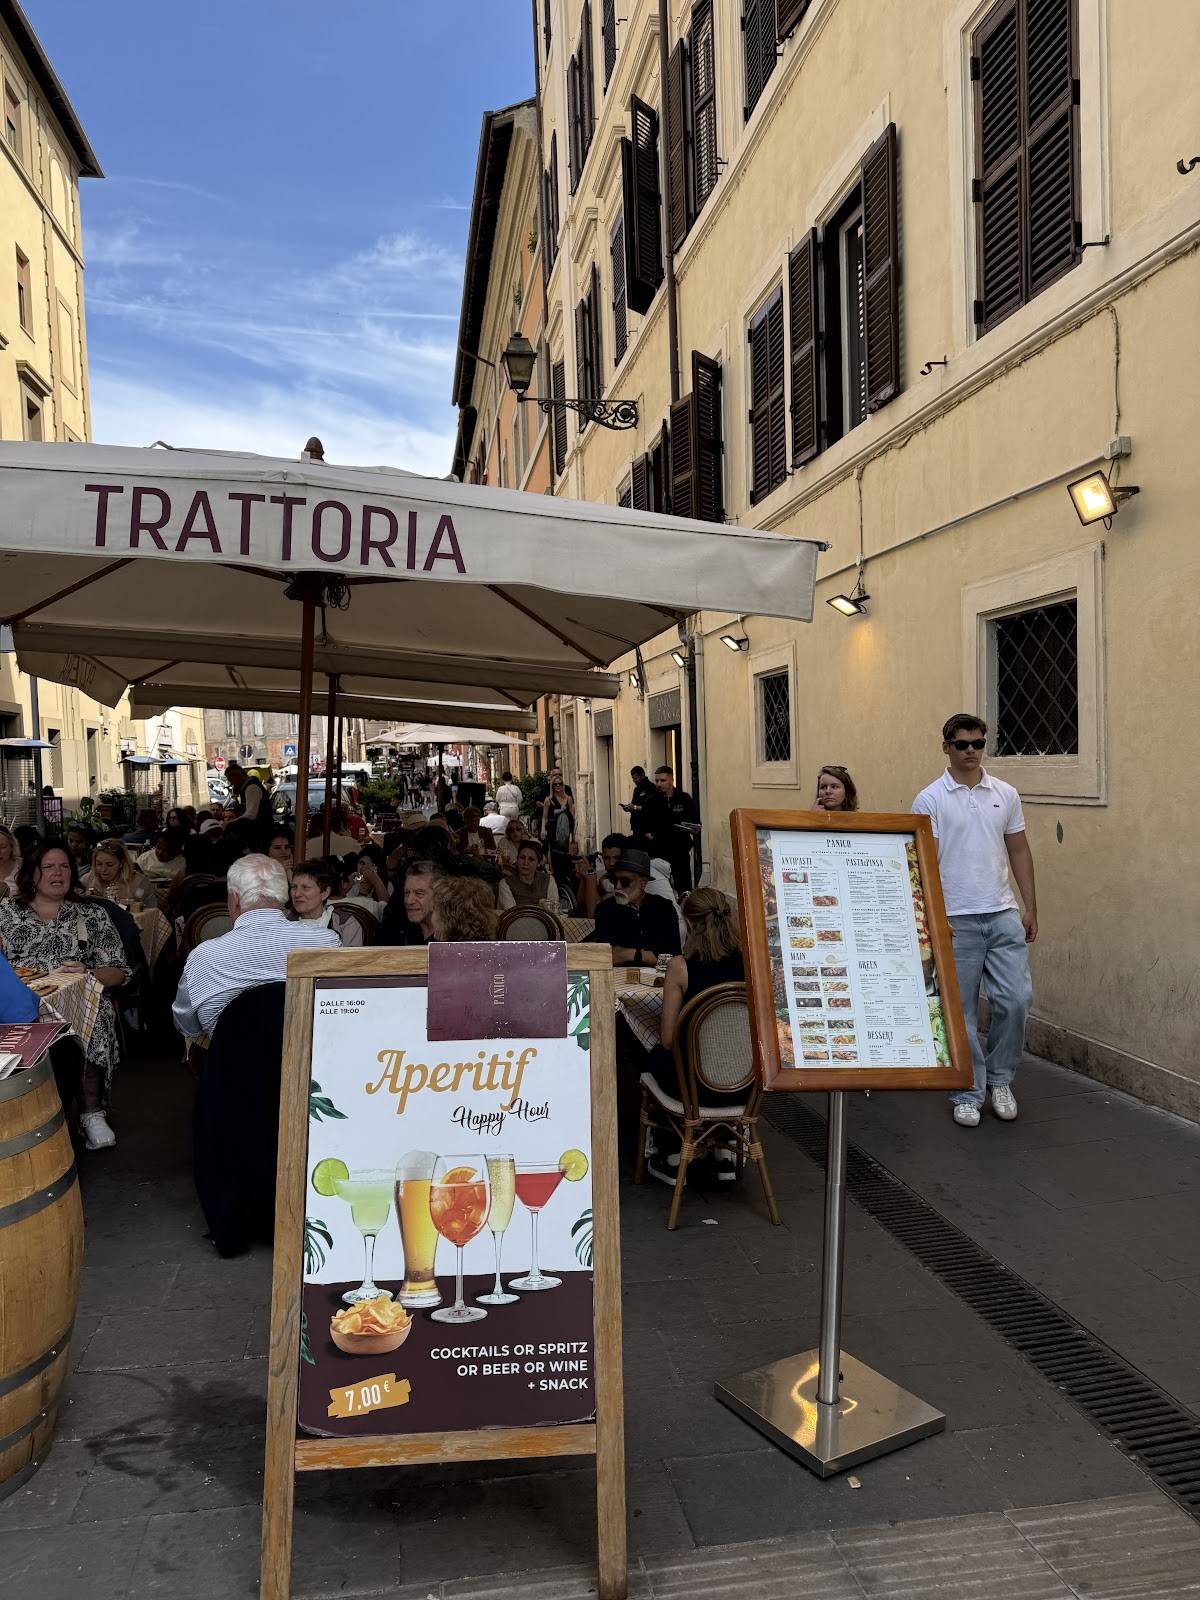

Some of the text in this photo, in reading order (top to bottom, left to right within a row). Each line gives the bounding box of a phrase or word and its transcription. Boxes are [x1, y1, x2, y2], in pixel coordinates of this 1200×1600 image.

[84, 484, 467, 574] TRATTORIA
[790, 952, 806, 960] MAIN
[858, 961, 878, 971] GREEN
[493, 974, 505, 1005] PANICO
[319, 999, 366, 1007] DALLE 16:00
[319, 1007, 360, 1015] ALLE 19:00
[867, 1031, 894, 1041] DESSERT
[365, 1047, 538, 1115] Aperitif
[450, 1097, 551, 1136] Happy Hour
[430, 1341, 588, 1360] COCKTAILS OR SPRITZ
[457, 1359, 588, 1377] OR BEER OR WINE
[527, 1377, 589, 1391] + SNACK
